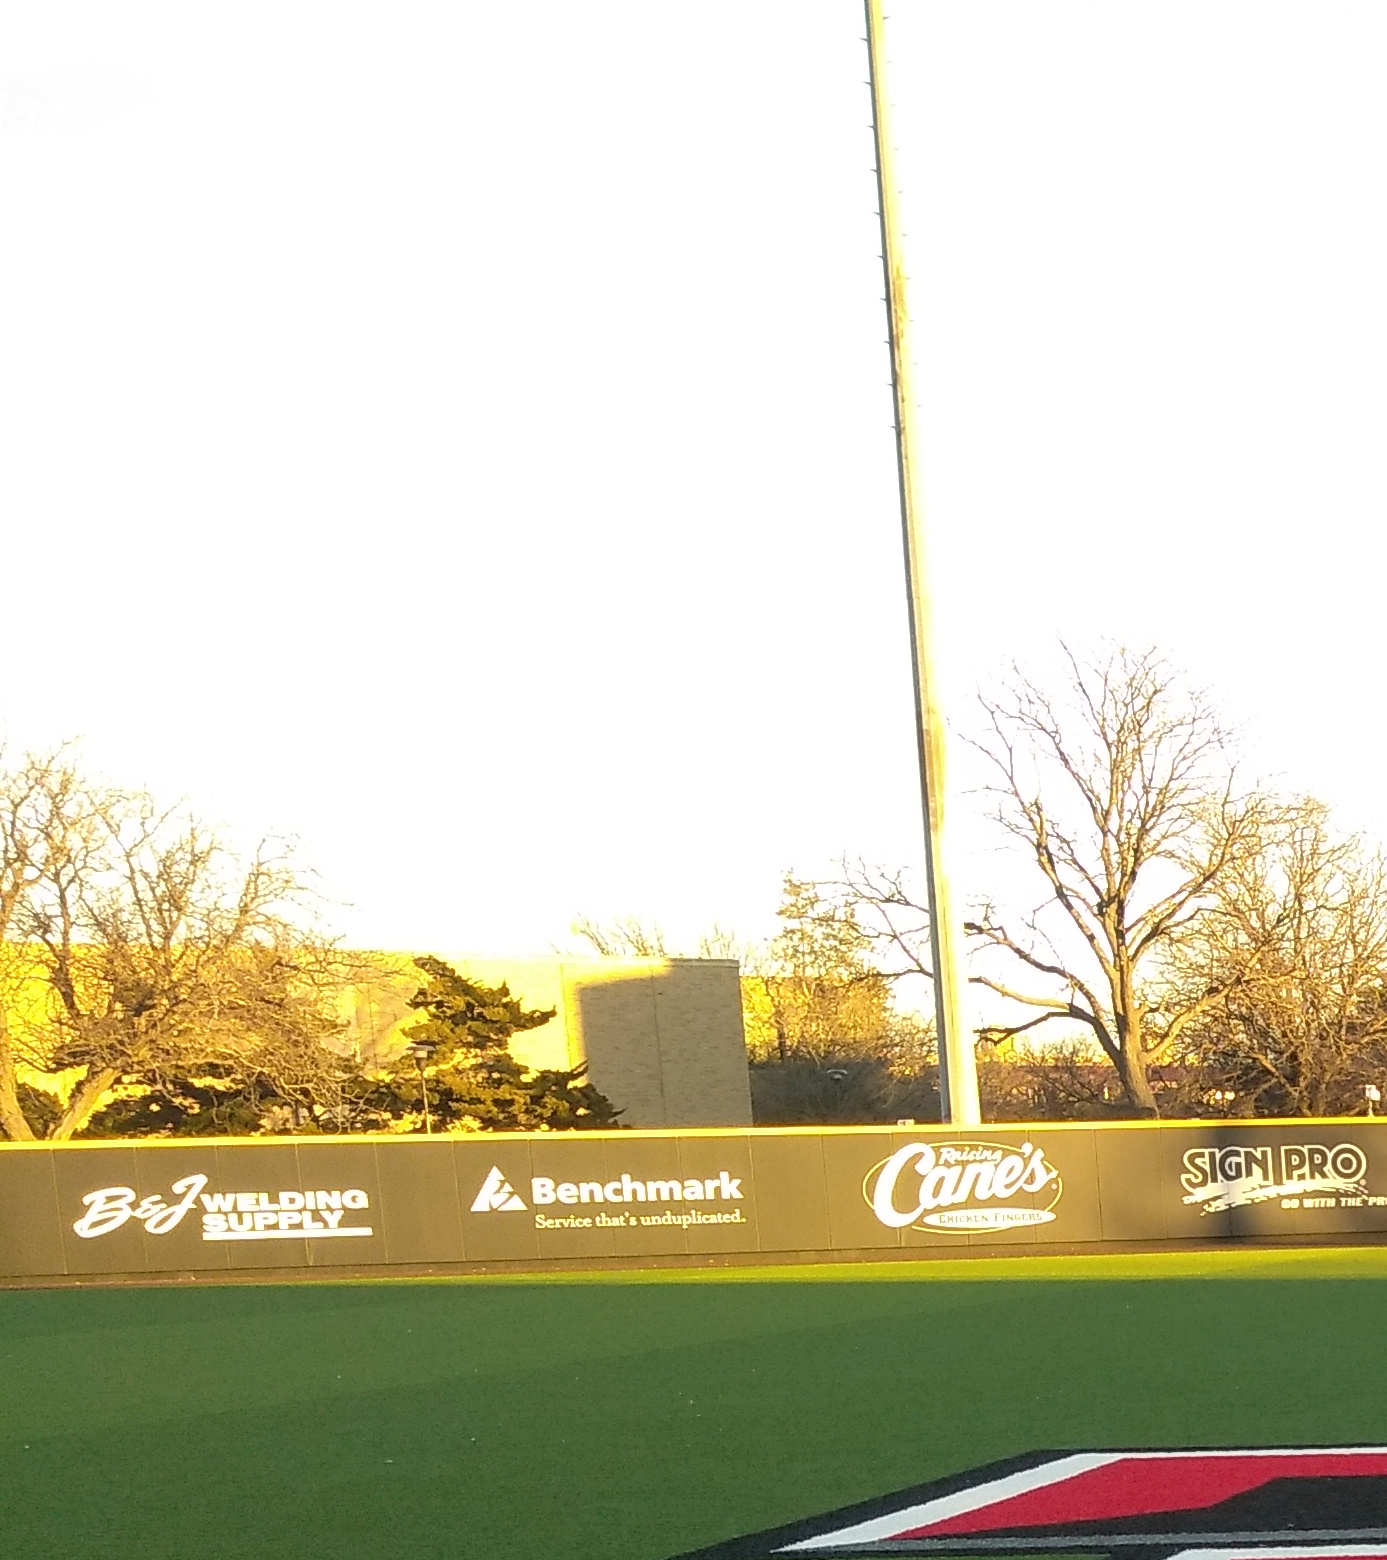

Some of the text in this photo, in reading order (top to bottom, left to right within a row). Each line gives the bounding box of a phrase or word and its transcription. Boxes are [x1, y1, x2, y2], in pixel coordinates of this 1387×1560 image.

[937, 1146, 1003, 1165] Raising
[1180, 1144, 1367, 1191] SIGN PRO
[531, 1171, 744, 1204] Benchmark
[874, 1142, 1059, 1228] Cane's
[73, 1173, 208, 1238] B&J
[200, 1189, 369, 1212] WELDING
[1281, 1199, 1299, 1209] GO
[1302, 1197, 1336, 1208] WITH
[1340, 1197, 1363, 1206] THE
[202, 1210, 344, 1232] SUPPLY
[535, 1209, 747, 1229] Service that's unduplicated.
